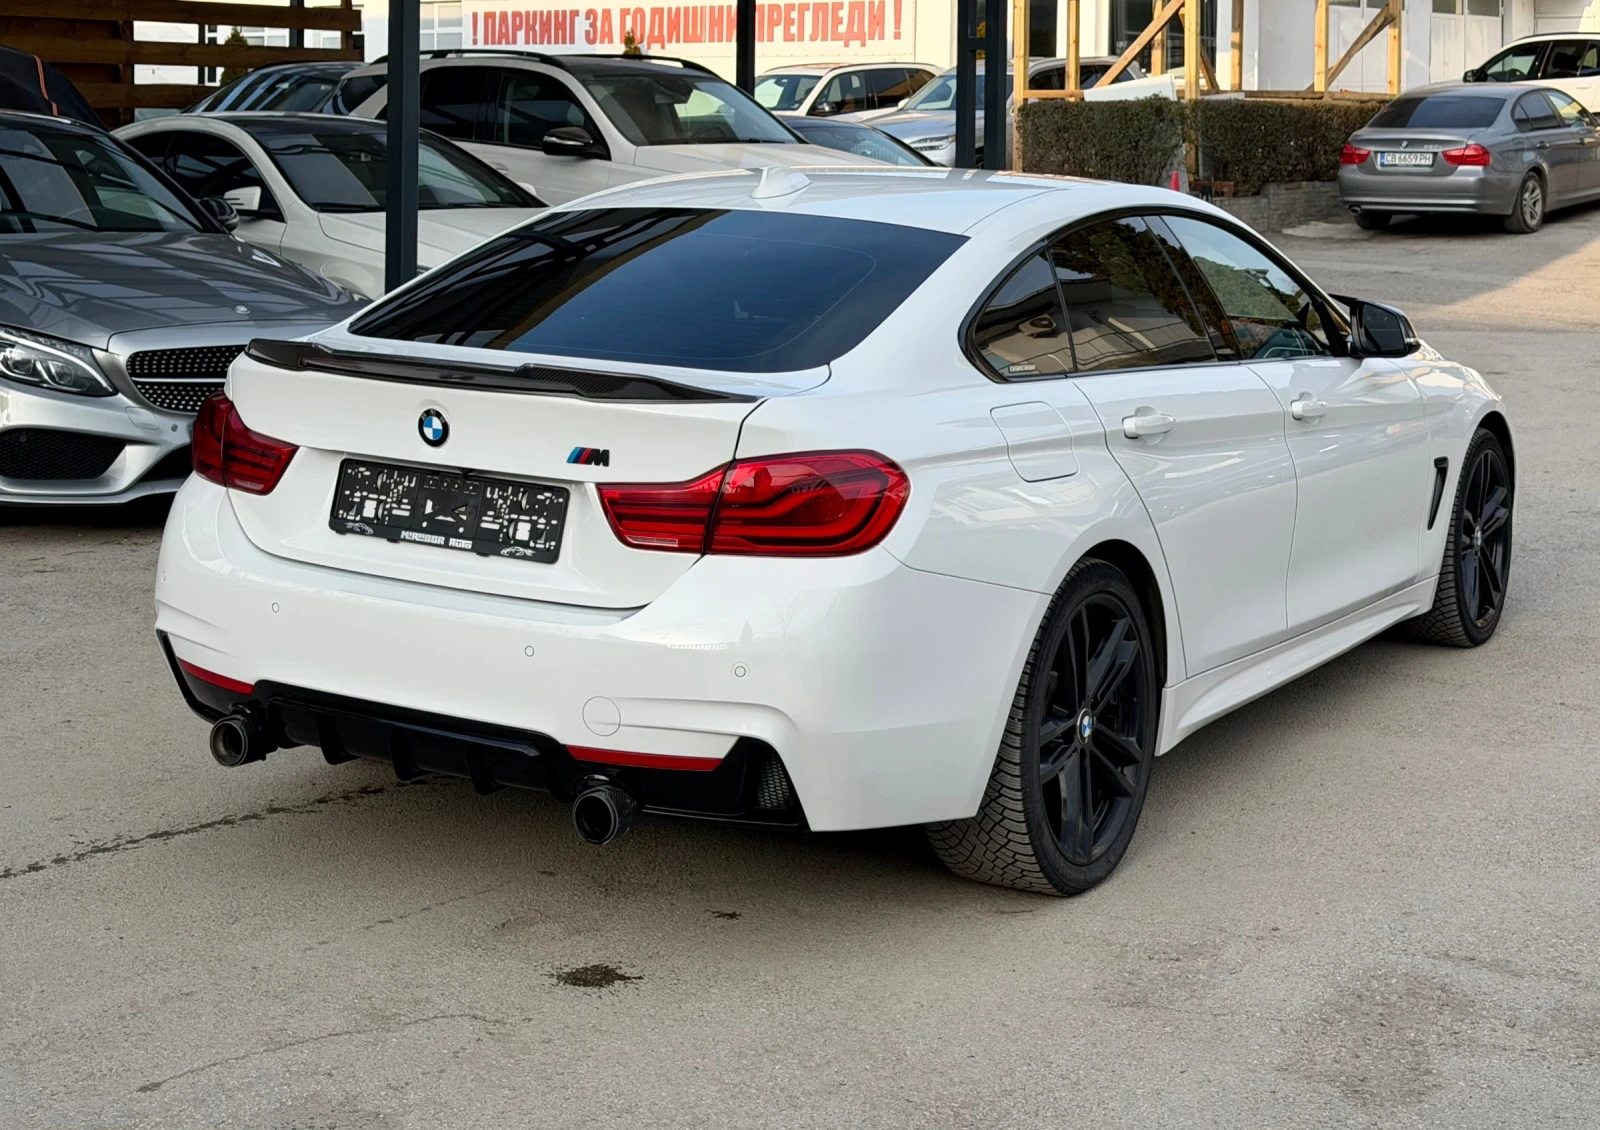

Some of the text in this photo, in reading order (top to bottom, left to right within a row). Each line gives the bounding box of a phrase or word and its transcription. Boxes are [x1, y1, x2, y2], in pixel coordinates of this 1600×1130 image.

[483, 9, 580, 46] ПАРКИНГ
[584, 7, 614, 45] ЗА
[1385, 153, 1431, 163] CB 6659 PH
[580, 447, 610, 467] M
